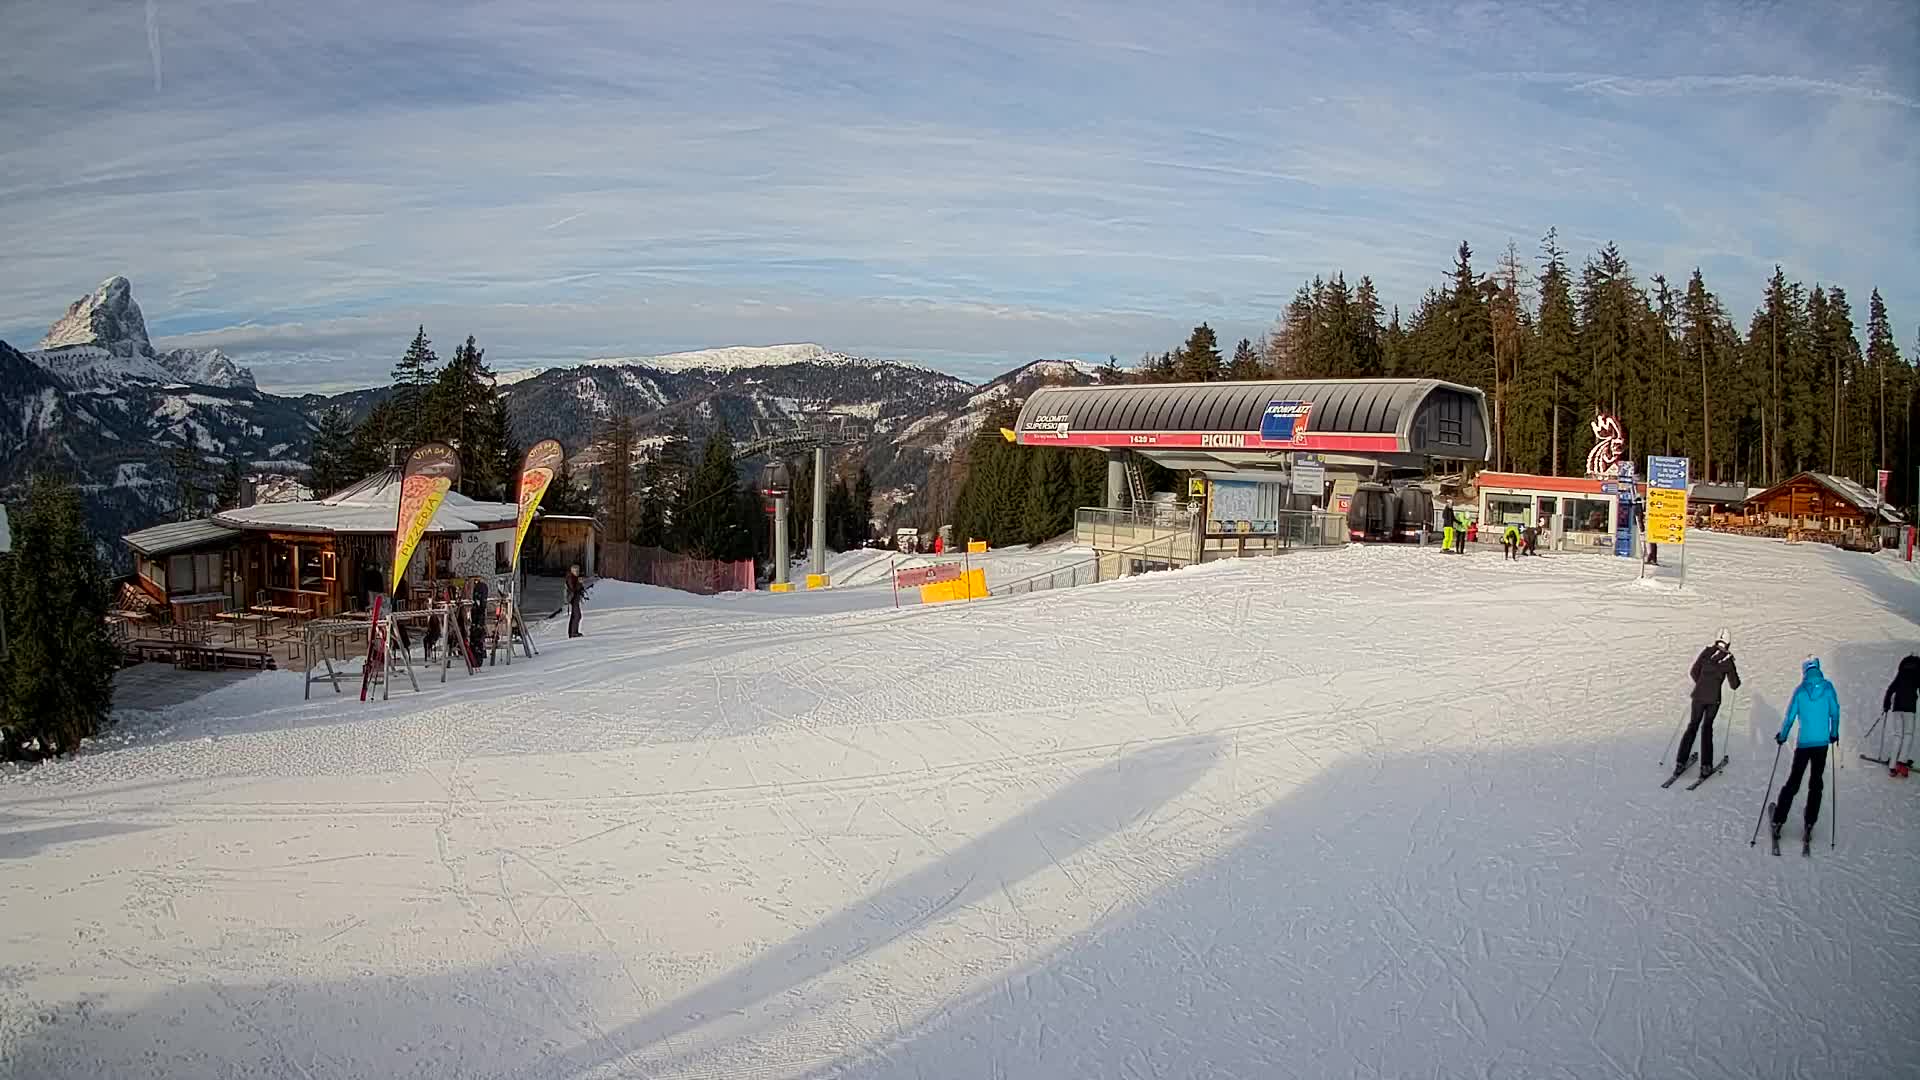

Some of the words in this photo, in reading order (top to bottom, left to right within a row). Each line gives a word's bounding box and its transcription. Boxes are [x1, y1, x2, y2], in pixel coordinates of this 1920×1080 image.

[1265, 405, 1310, 414] KRONPLATZ
[1025, 422, 1058, 430] SUPERSKI
[1201, 434, 1245, 447] PICULIN
[401, 498, 438, 557] PIZZERIA
